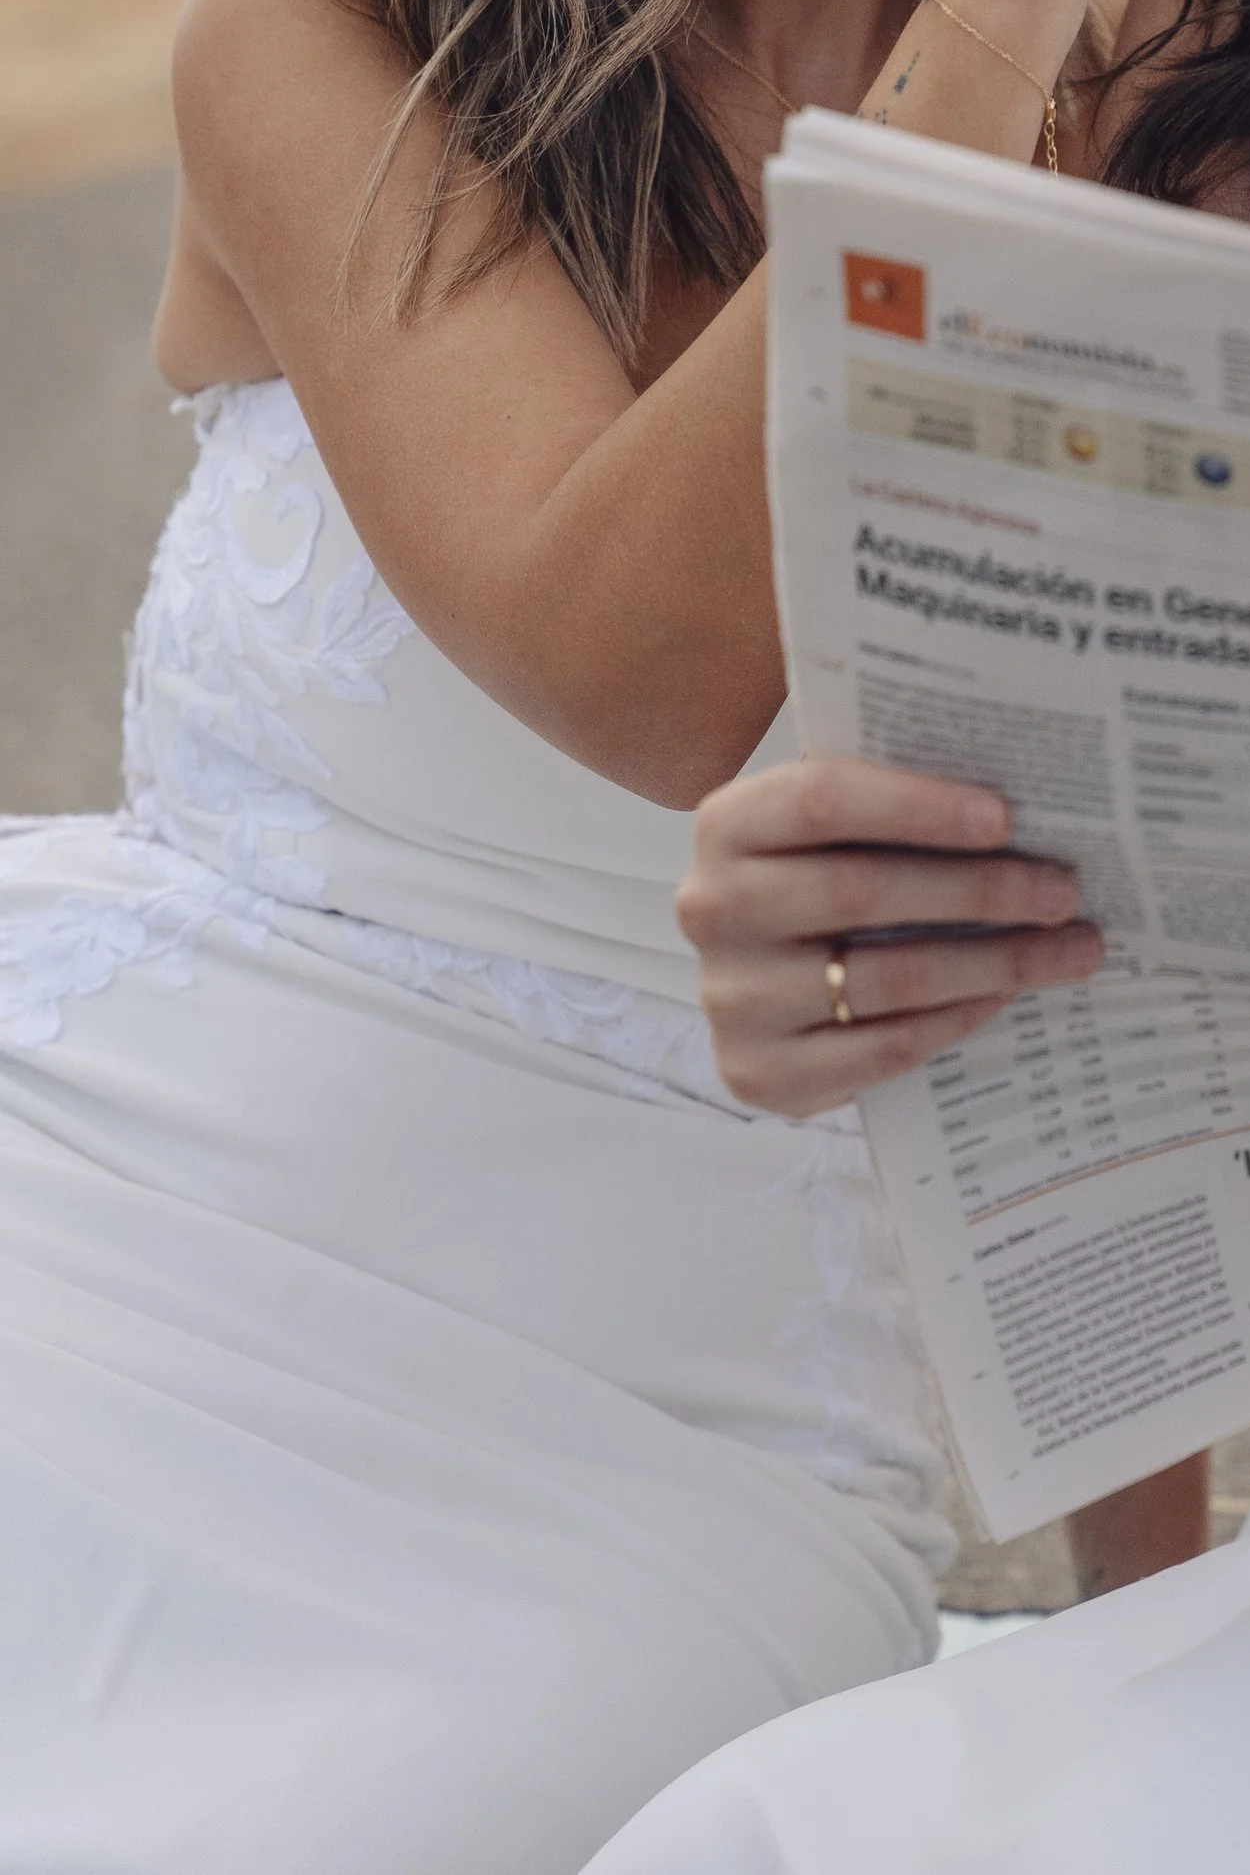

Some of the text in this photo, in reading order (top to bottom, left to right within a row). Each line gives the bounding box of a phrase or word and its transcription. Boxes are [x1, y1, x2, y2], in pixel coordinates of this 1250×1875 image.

[852, 520, 1095, 611] Acumulación
[1104, 583, 1153, 617] en
[853, 563, 1063, 643] Maquinaria
[1069, 616, 1093, 652] y
